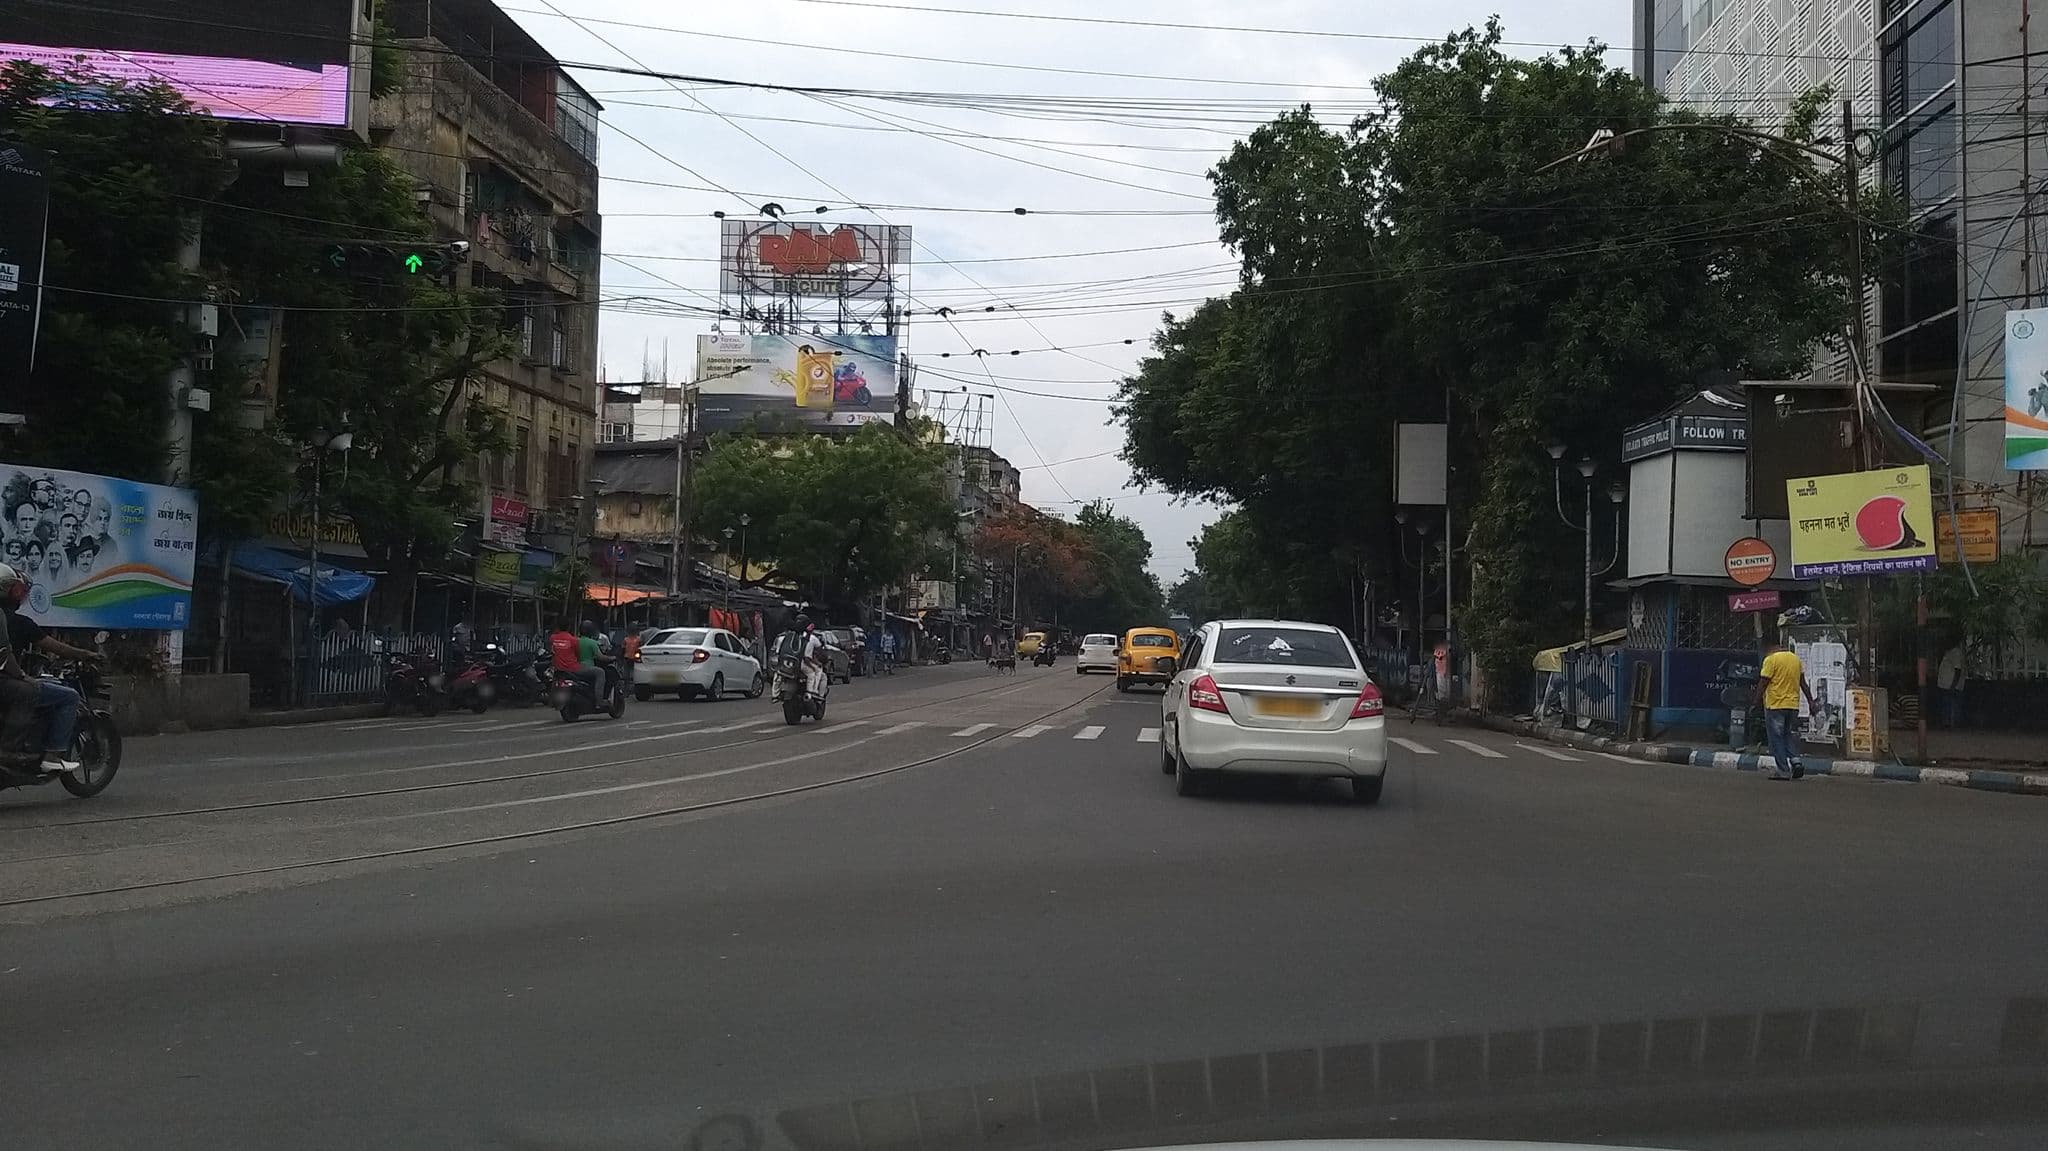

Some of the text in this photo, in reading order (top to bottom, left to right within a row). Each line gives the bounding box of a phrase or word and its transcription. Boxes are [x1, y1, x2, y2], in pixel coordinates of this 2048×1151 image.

[759, 229, 862, 274] RAJA
[774, 280, 842, 293] BISCUITS
[1656, 429, 1669, 443] POLICE
[1683, 426, 1745, 440] FOLLOW TR
[1799, 517, 1823, 533] पहनना
[1824, 516, 1836, 530] मत
[1730, 556, 1770, 567] NO ENTRY
[1803, 566, 1823, 577] हेलमेट
[1884, 562, 1895, 570] का
